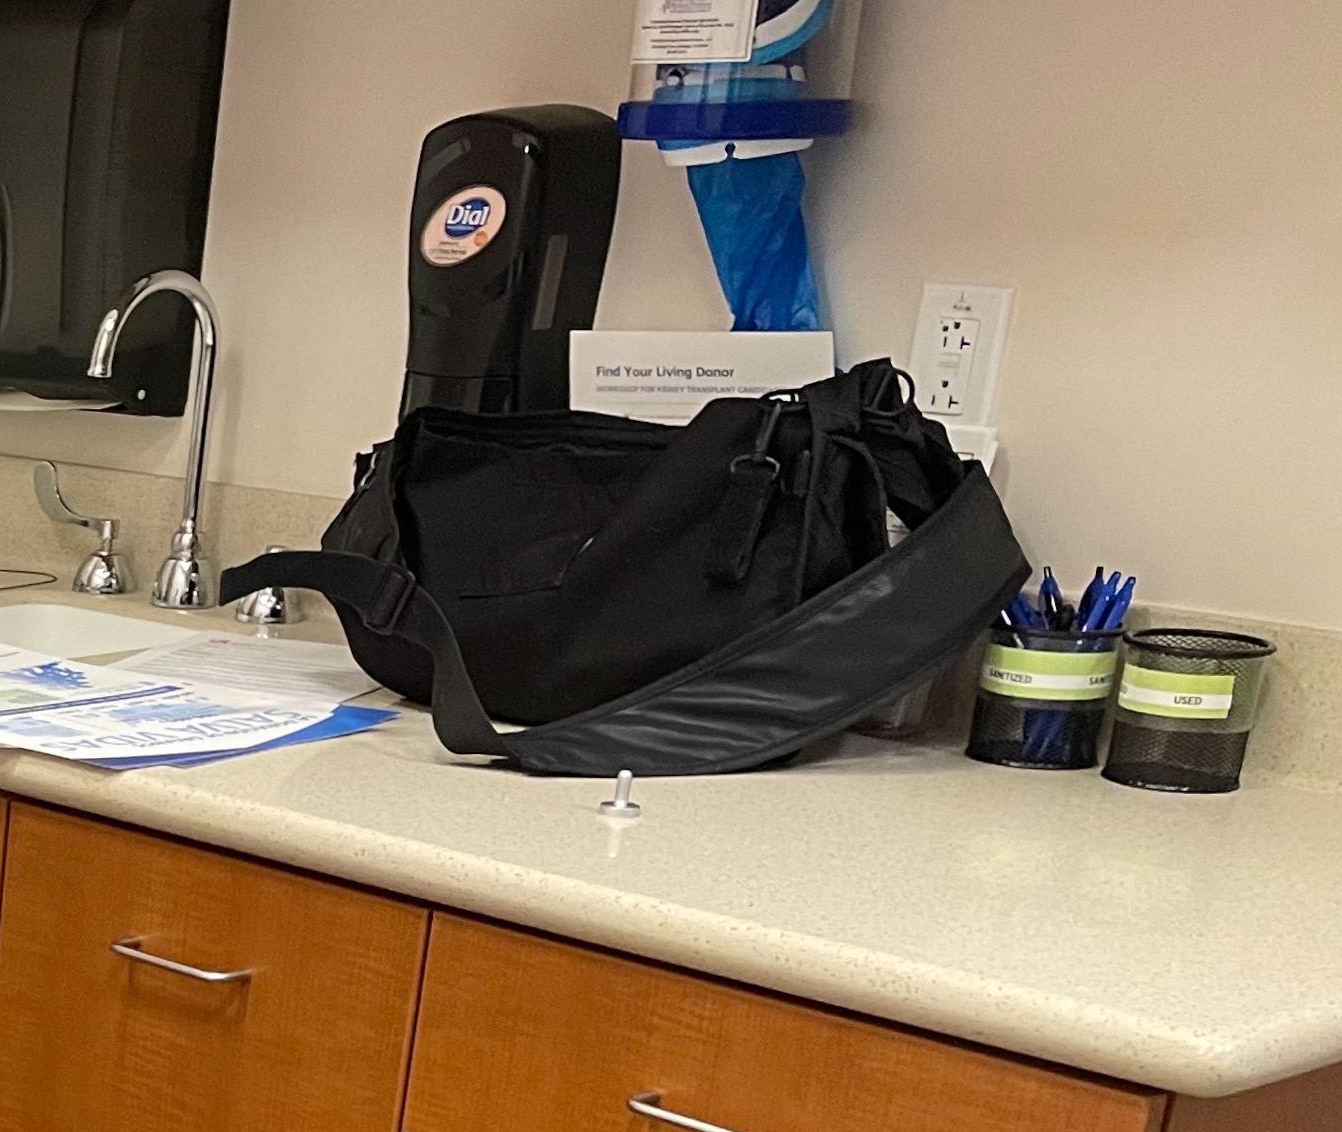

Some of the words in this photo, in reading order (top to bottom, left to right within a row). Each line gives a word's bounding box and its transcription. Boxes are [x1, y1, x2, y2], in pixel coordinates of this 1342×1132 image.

[447, 204, 490, 226] Dial
[596, 366, 621, 377] Find
[624, 366, 653, 377] Your
[656, 365, 692, 379] Living
[696, 367, 735, 377] Donor
[989, 668, 1032, 684] SANITIZED
[1173, 696, 1202, 705] USED
